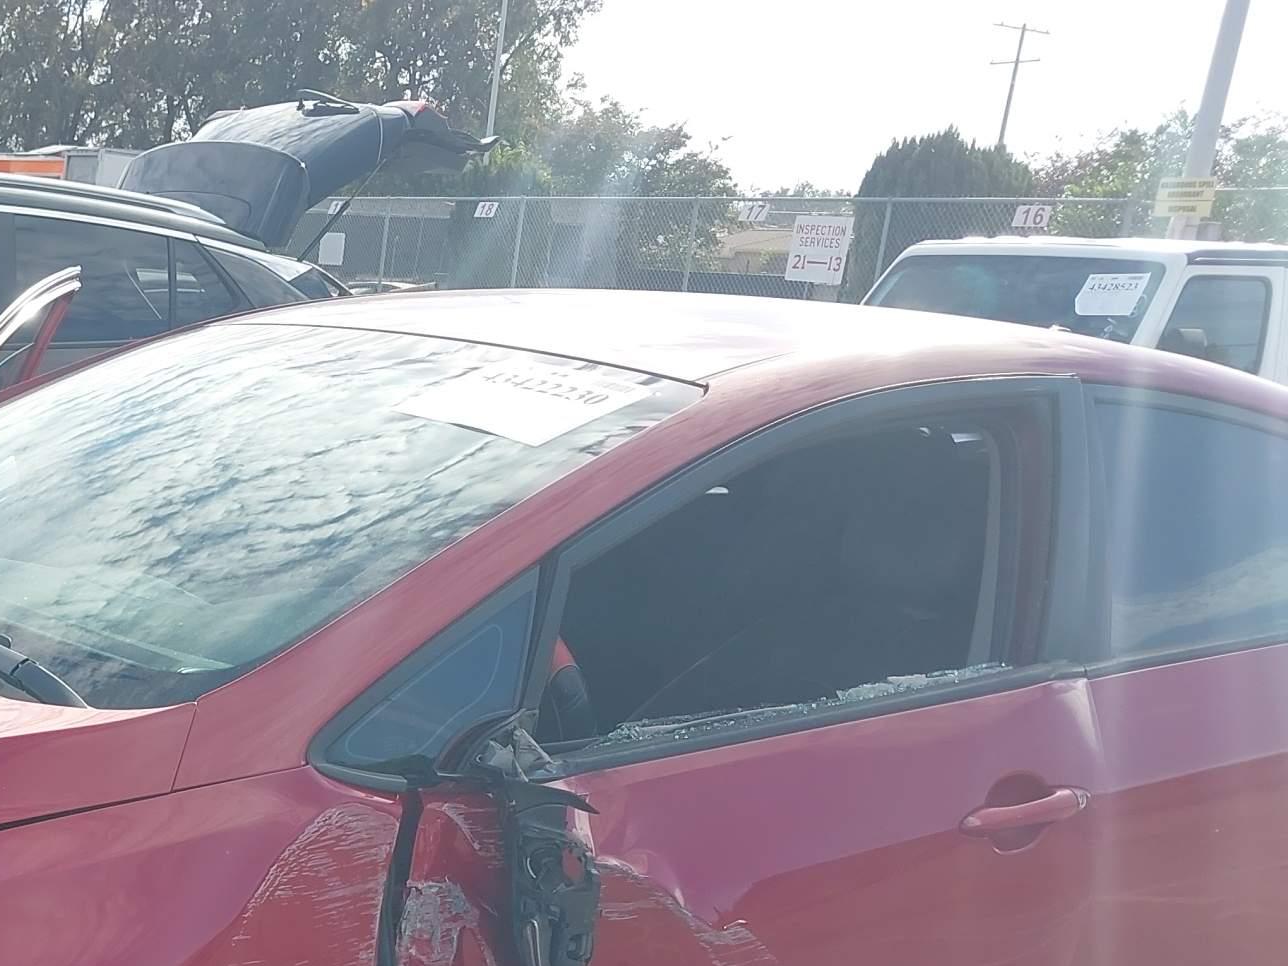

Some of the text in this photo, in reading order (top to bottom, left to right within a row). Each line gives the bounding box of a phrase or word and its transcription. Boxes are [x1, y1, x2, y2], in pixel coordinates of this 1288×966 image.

[479, 203, 495, 216] 18
[747, 205, 767, 220] 17
[1022, 207, 1046, 225] 16
[796, 224, 847, 237] INSPECTION
[800, 236, 841, 249] SERVICES
